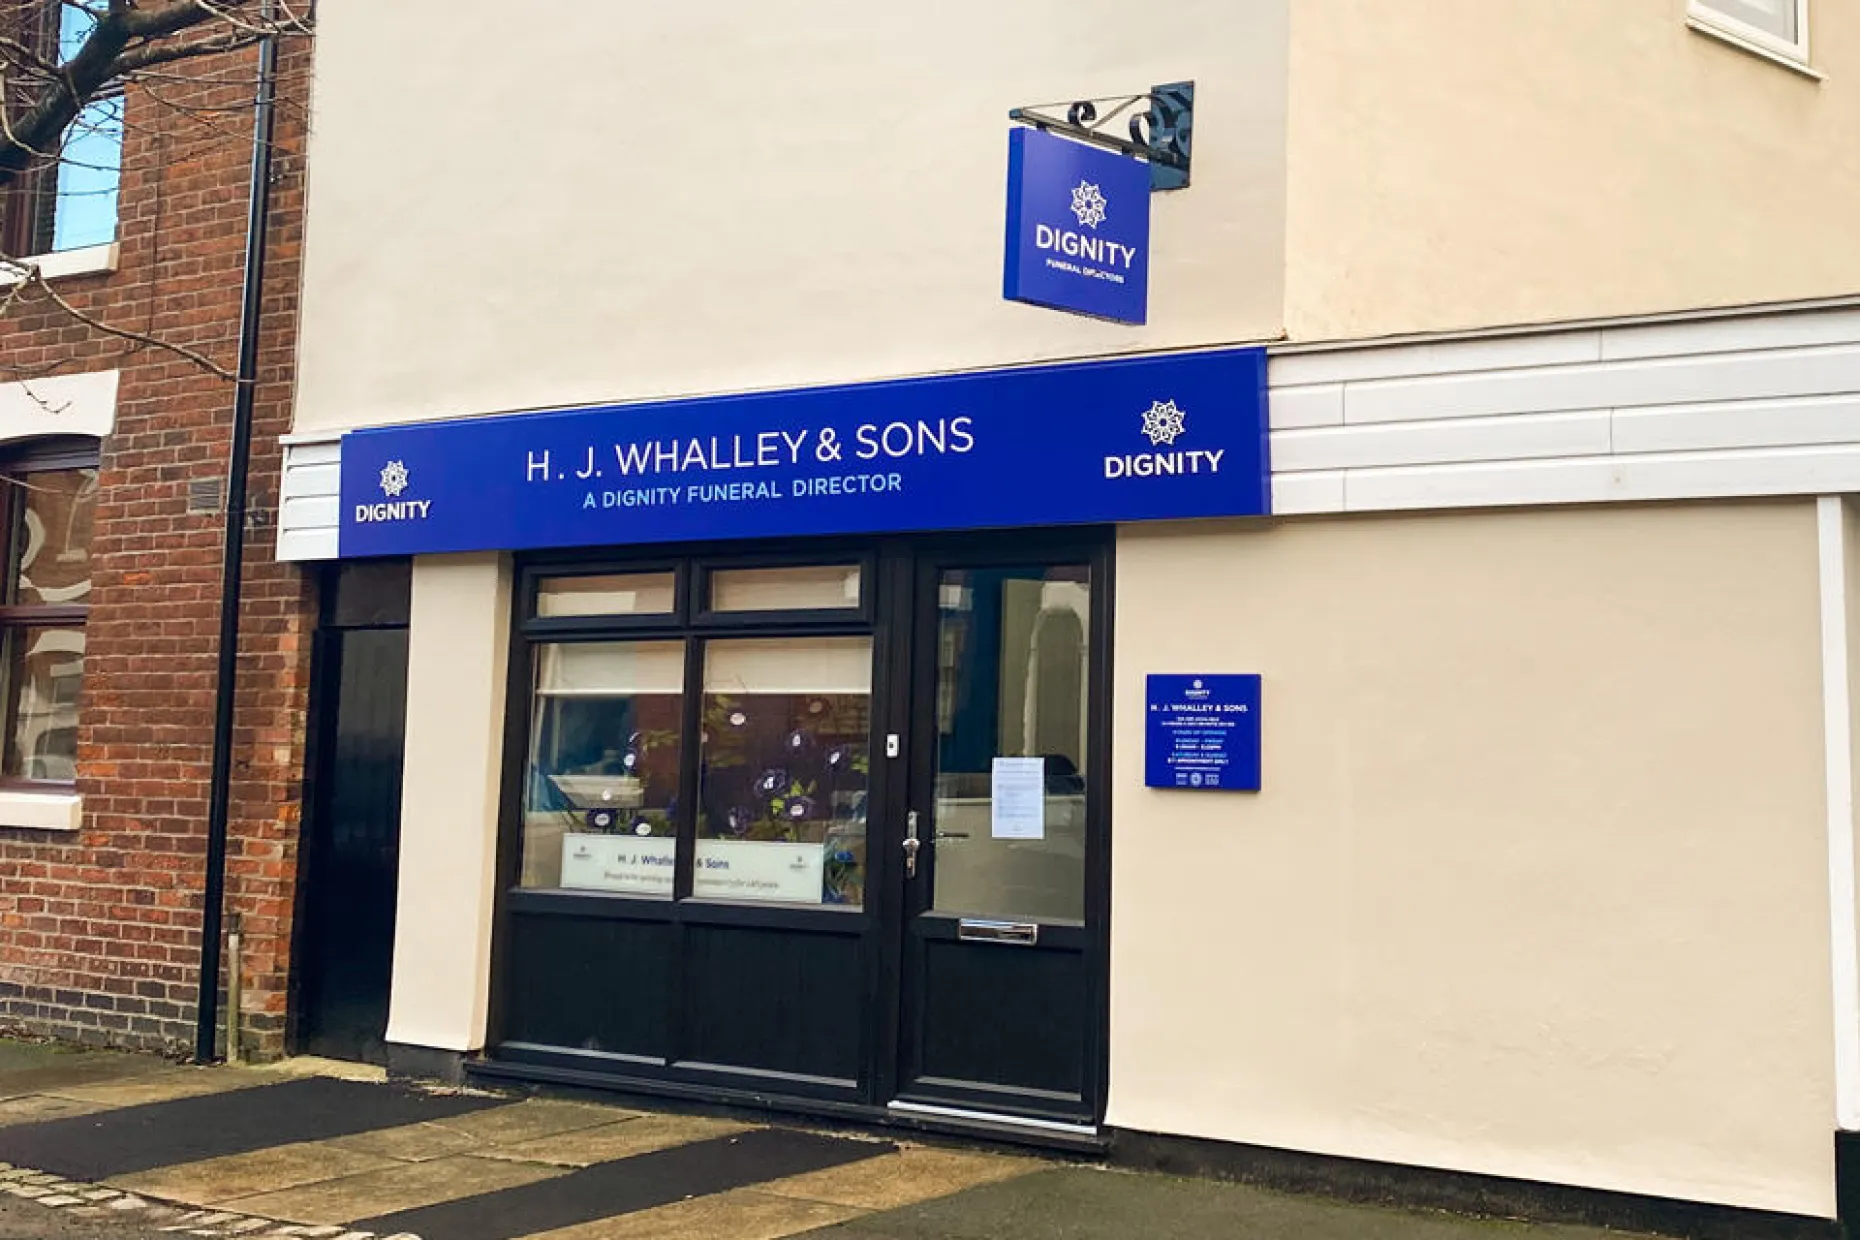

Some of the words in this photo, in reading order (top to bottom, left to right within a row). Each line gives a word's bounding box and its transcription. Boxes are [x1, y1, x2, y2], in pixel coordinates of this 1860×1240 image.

[1036, 224, 1136, 269] DIGNITY
[526, 449, 565, 481] H.
[576, 446, 602, 479] J.
[615, 431, 808, 475] WHALLEY
[815, 427, 842, 462] &
[855, 416, 974, 459] SONS
[1105, 449, 1225, 478] DIGNITY
[582, 491, 597, 509] A
[602, 487, 681, 508] DIGNITY
[687, 481, 783, 503] FUNERAL
[793, 472, 902, 497] DIRECTOR
[355, 499, 431, 522] DIGNITY
[1171, 704, 1214, 712] WHALLEY
[1223, 704, 1249, 713] SONS
[641, 854, 674, 867] Whalle
[705, 858, 730, 869] Sons
